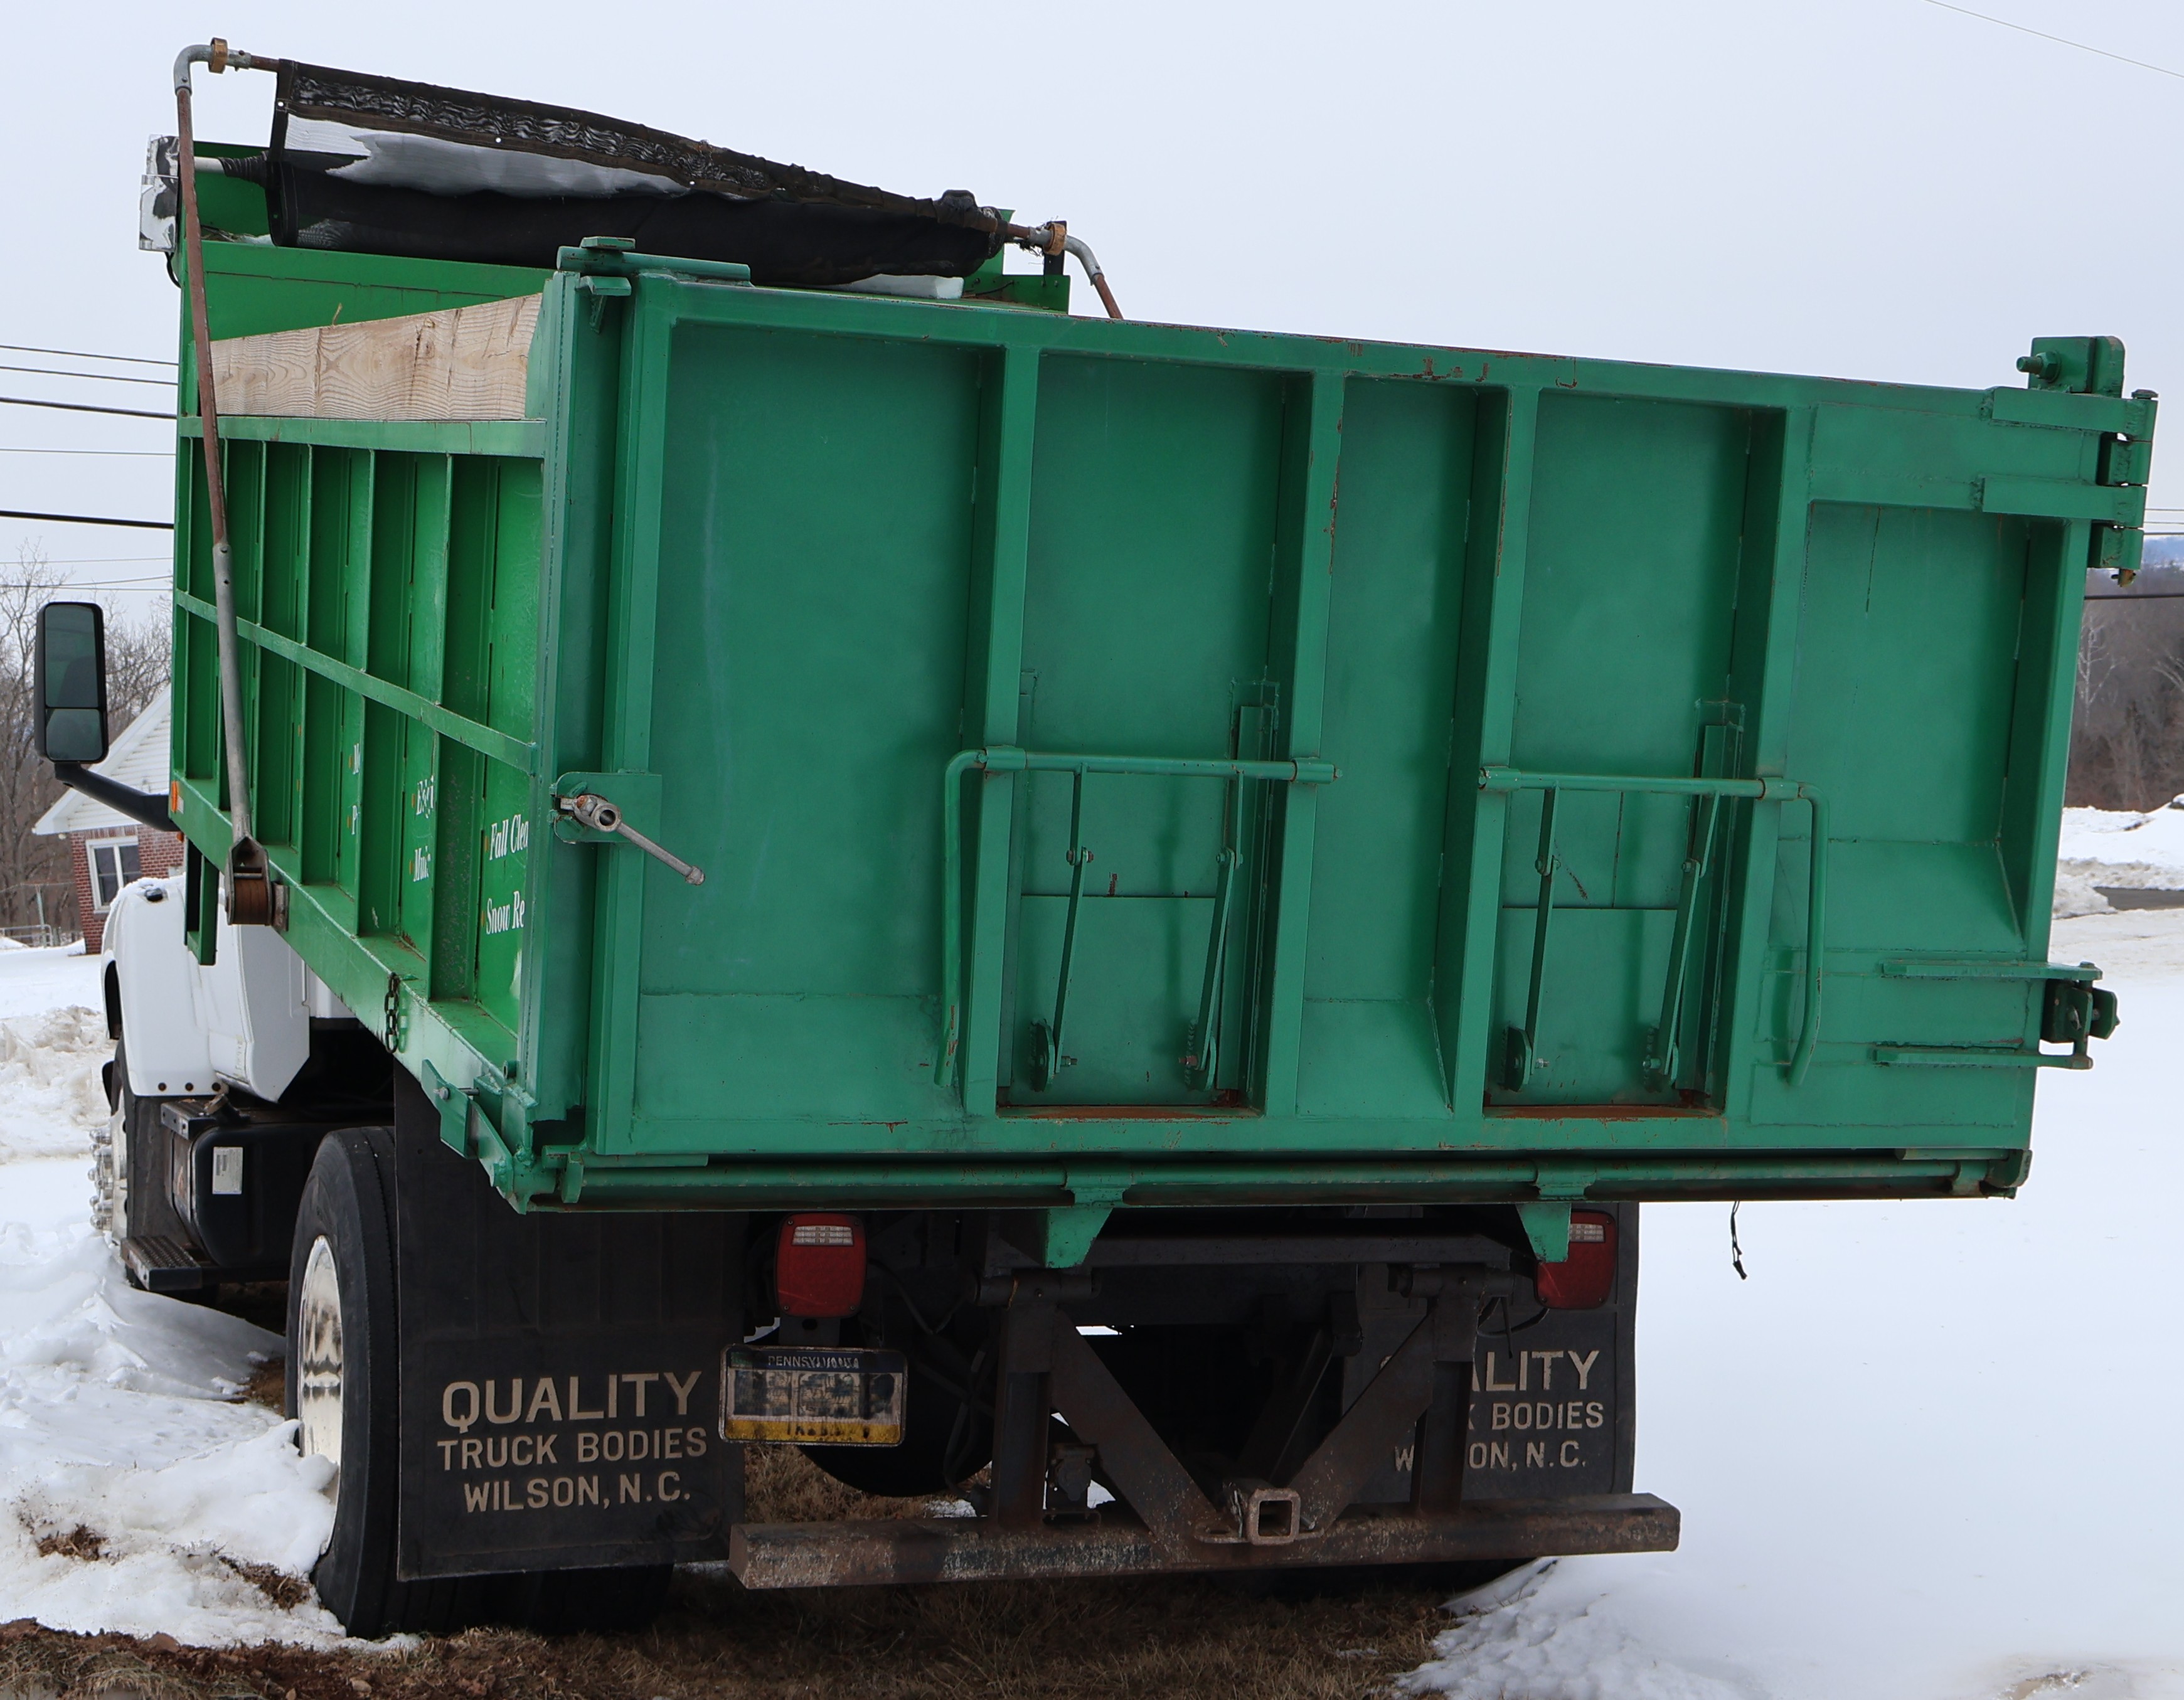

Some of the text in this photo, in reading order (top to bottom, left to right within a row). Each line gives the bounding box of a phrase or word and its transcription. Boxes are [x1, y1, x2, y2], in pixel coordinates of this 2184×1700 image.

[489, 819, 509, 861] Fall
[486, 890, 525, 935] Snow Re
[1472, 1350, 1600, 1392] LITY
[442, 1371, 702, 1434] QUALITY
[1492, 1401, 1604, 1431] BODIES
[437, 1428, 707, 1471] TRUCK BODIES
[1394, 1440, 1586, 1472] WON, N.C.
[464, 1471, 691, 1513] WILSON, N.C.
